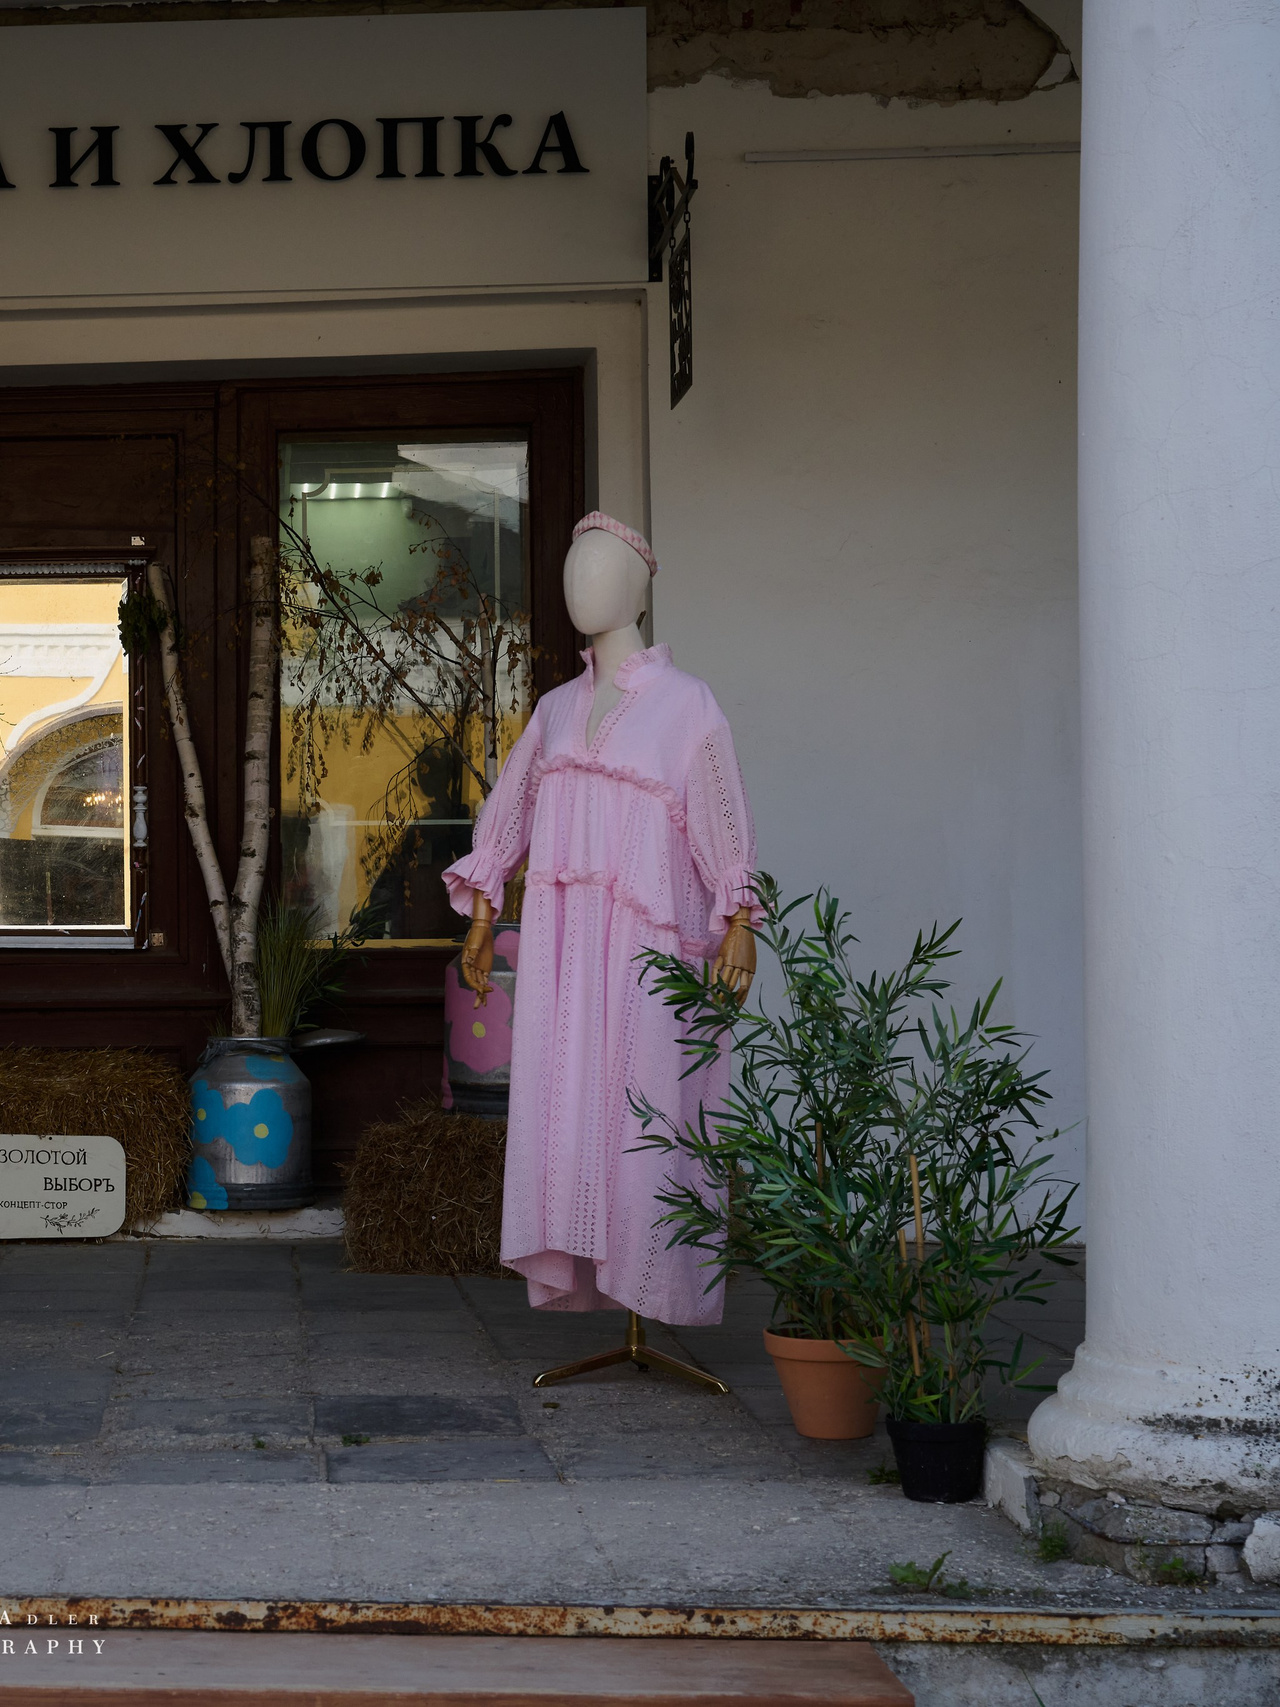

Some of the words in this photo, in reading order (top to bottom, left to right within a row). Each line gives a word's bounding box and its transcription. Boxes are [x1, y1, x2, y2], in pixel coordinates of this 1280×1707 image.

[48, 125, 121, 188] И
[152, 110, 591, 185] ХЛОПКА
[43, 1176, 115, 1192] ВЫБОРЪ
